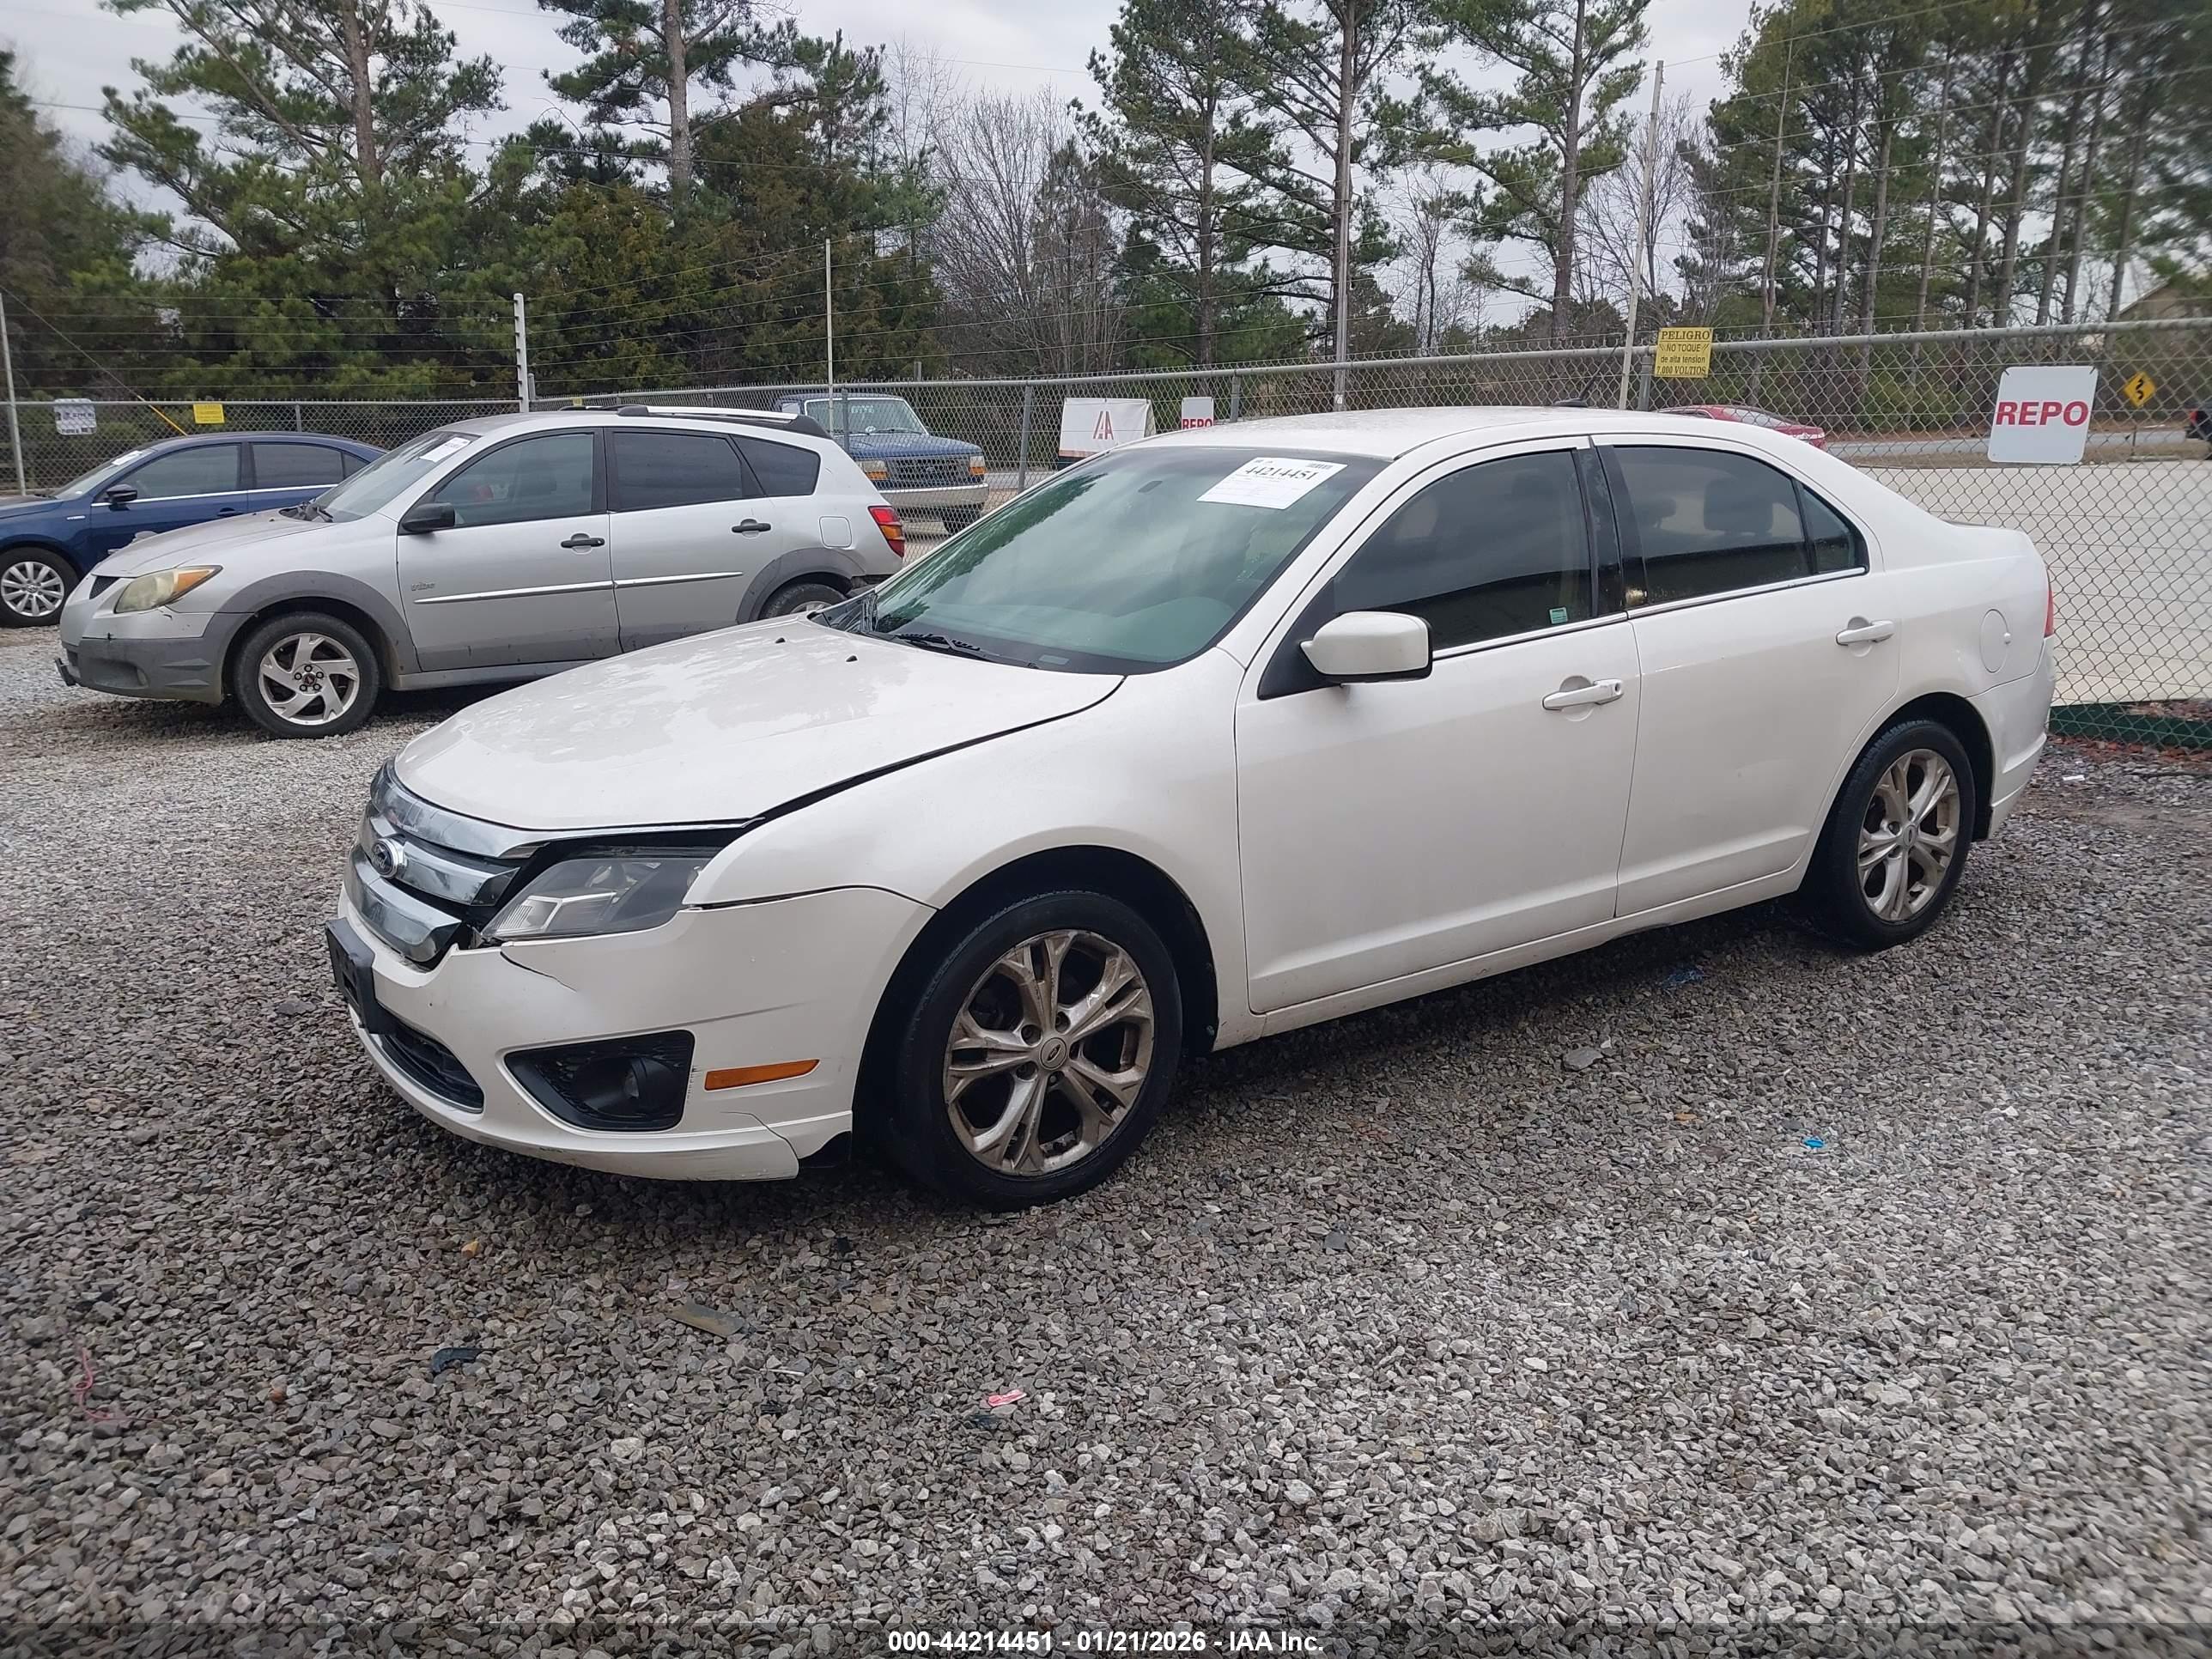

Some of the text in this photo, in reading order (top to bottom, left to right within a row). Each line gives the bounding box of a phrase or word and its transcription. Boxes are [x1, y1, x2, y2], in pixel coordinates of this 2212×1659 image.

[1662, 331, 1710, 340] PELIGRO
[1679, 343, 1700, 352] TOQUE
[1674, 366, 1706, 374] VOLTIOS
[1996, 400, 2089, 427] REPO
[1245, 465, 1320, 480] 44214451
